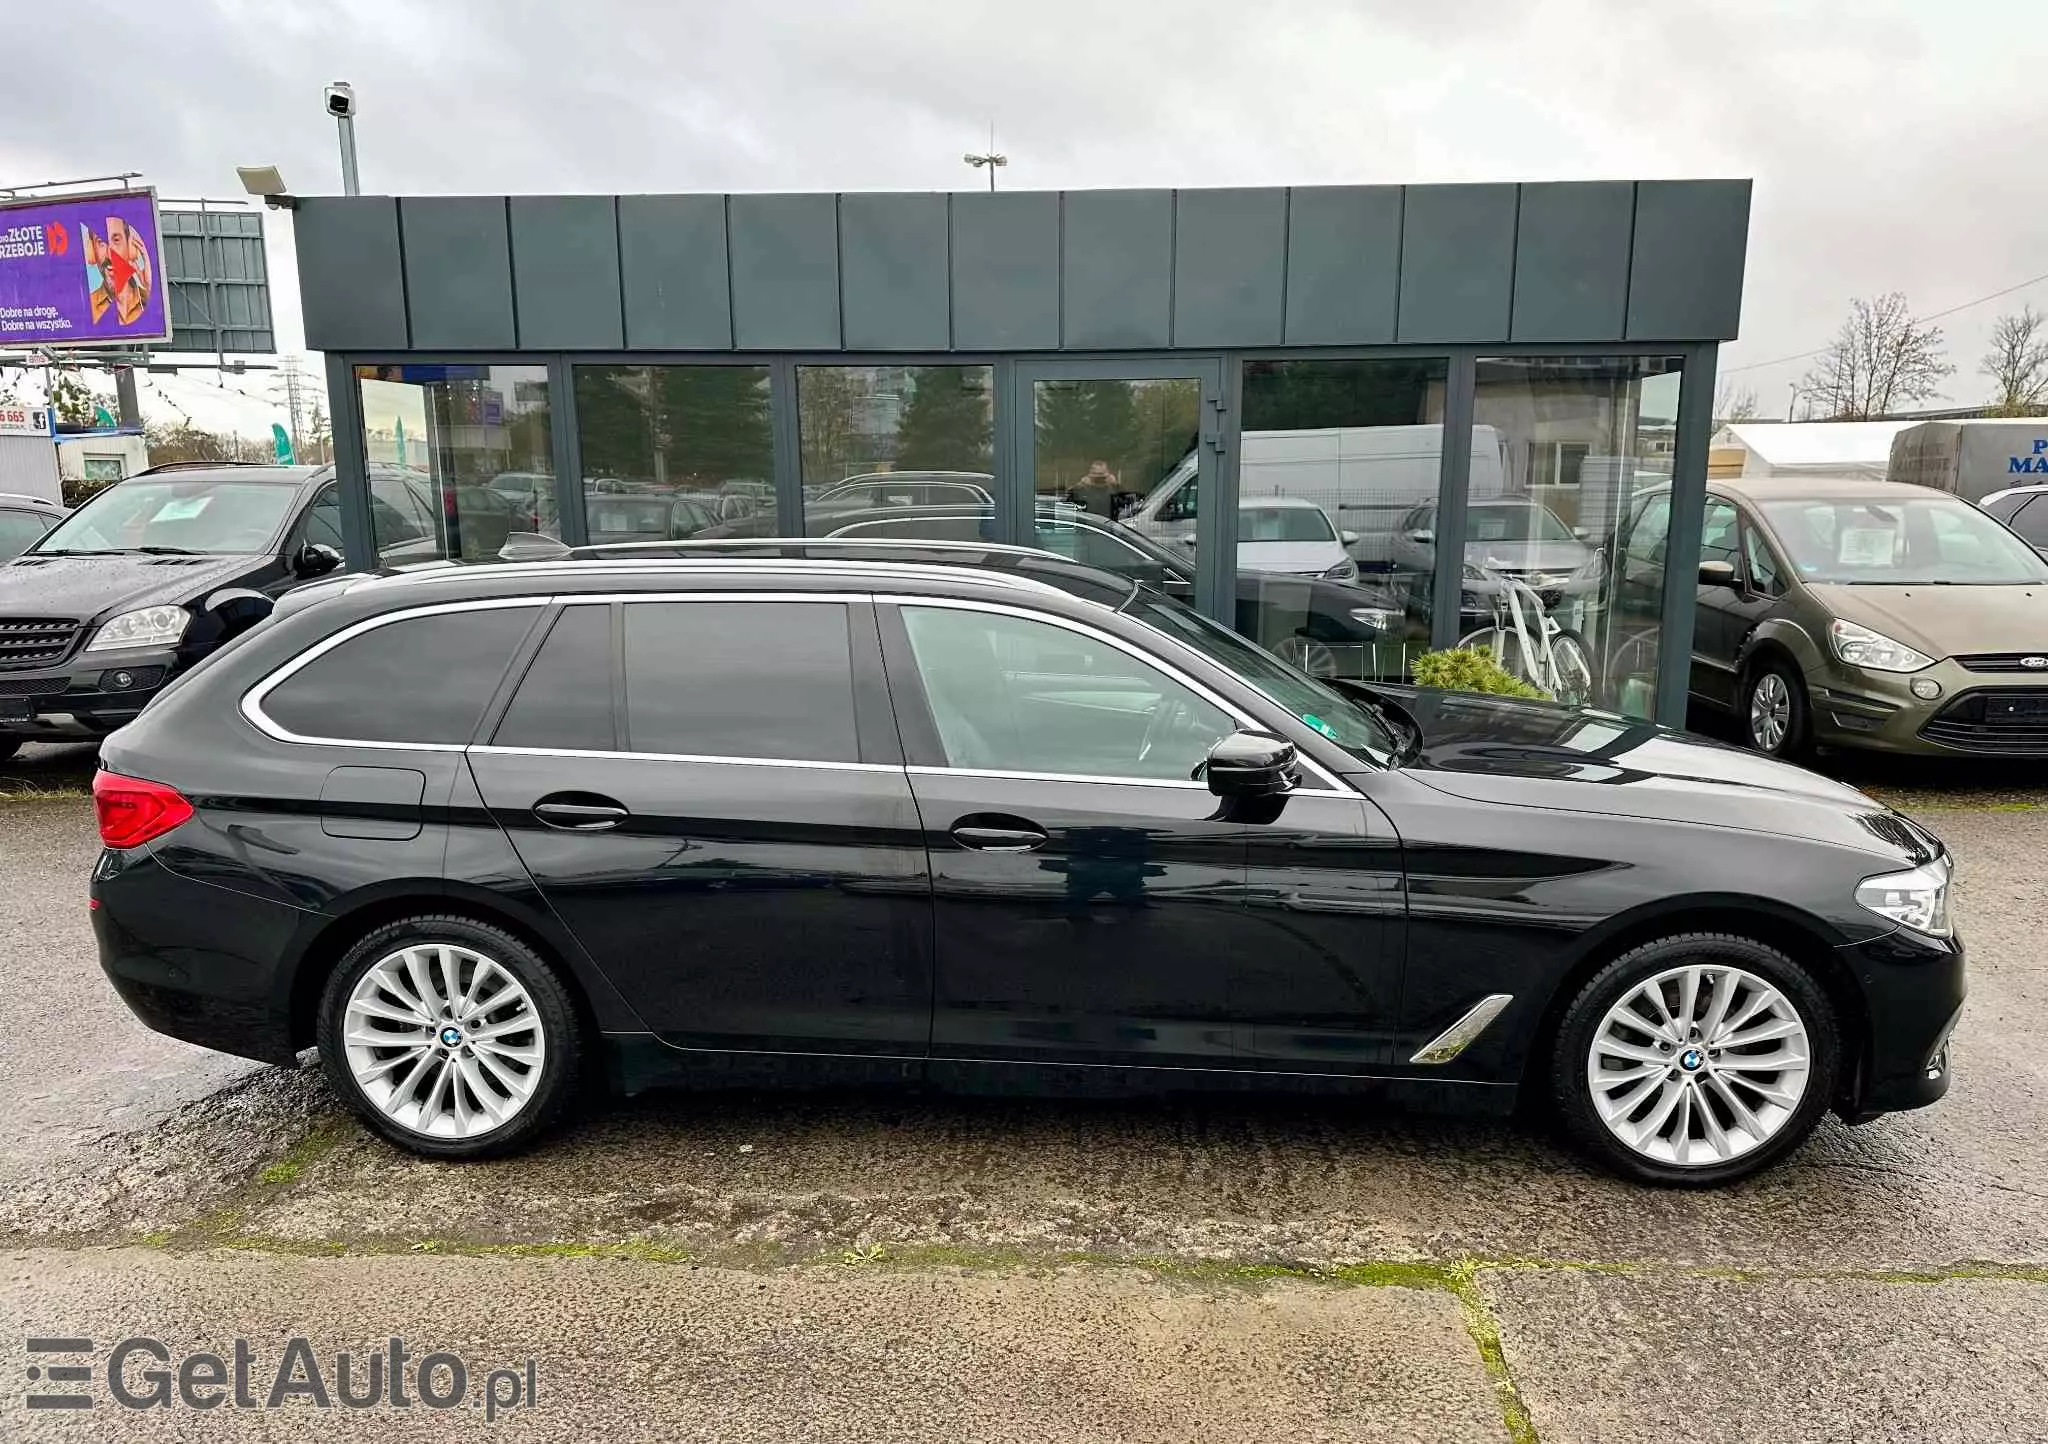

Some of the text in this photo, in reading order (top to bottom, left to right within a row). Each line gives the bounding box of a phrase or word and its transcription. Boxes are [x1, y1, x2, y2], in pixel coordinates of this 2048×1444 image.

[8, 226, 43, 242] ZŁOTE
[0, 307, 22, 318] Dobre
[23, 308, 33, 317] na
[1, 317, 73, 331] Dobre na wszystko.
[7, 410, 25, 422] 665
[2008, 457, 2048, 473] MA
